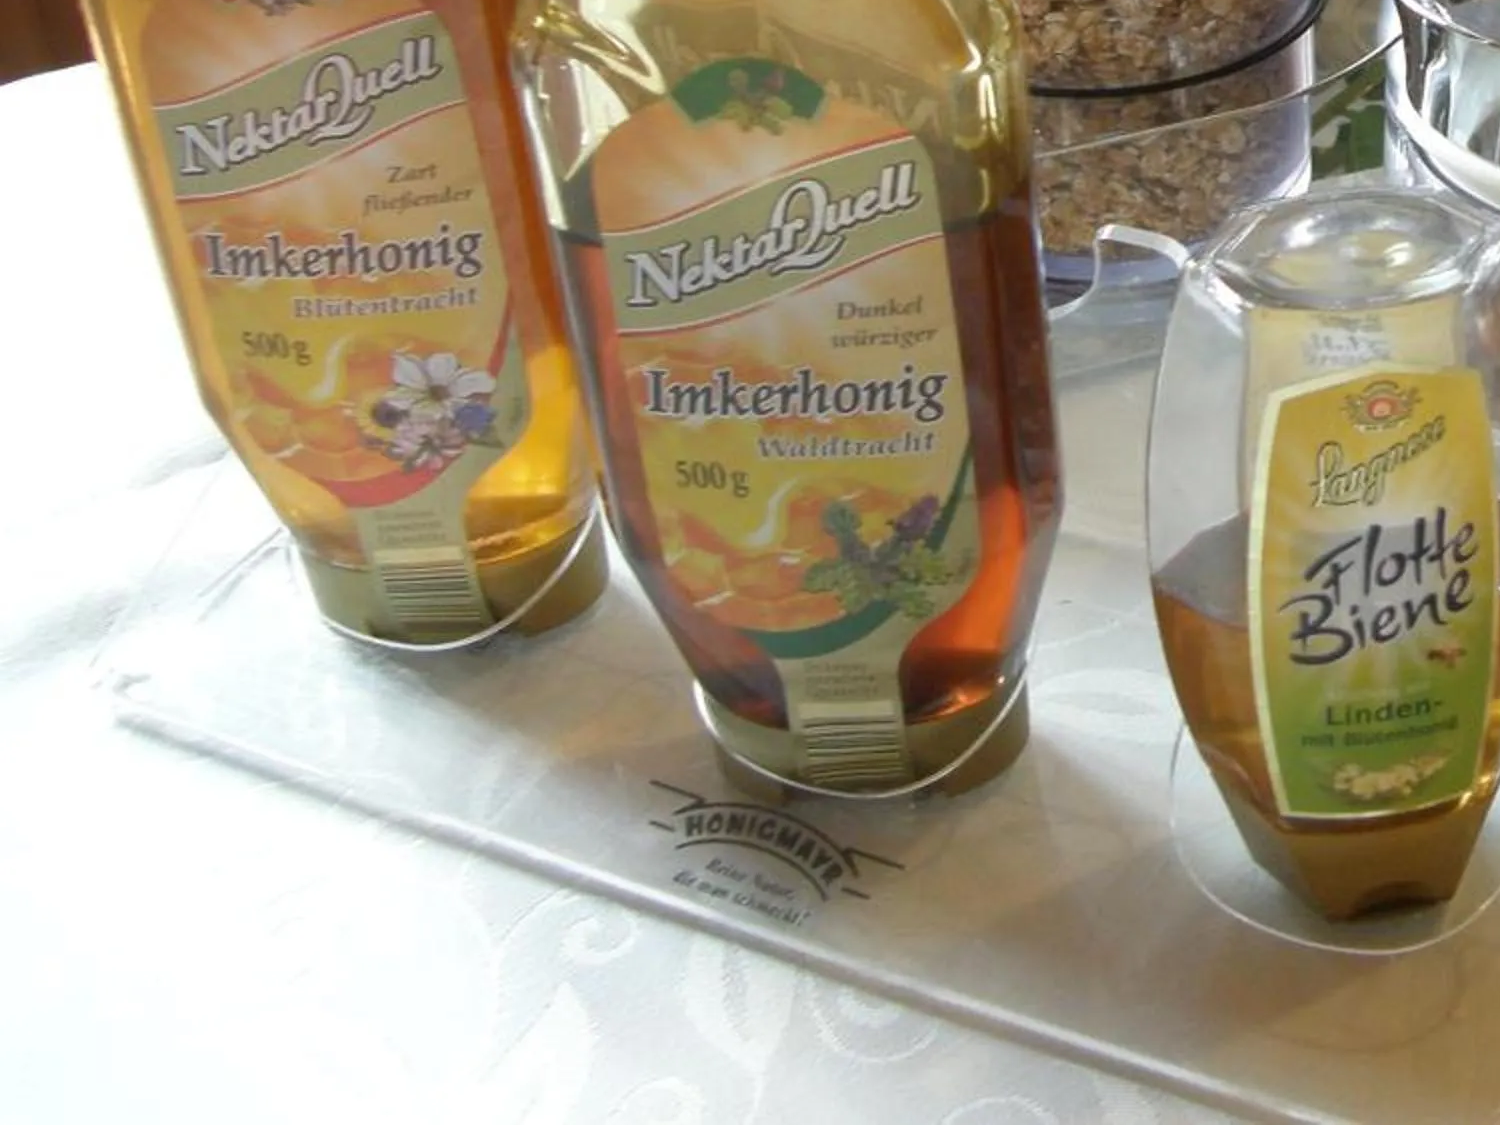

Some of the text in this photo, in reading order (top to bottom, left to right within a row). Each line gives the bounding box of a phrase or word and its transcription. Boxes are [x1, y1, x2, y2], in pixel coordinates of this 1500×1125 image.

[205, 225, 483, 278] Imkerhonig
[293, 287, 477, 318] Blütentracht
[837, 295, 923, 320] Dunkel
[646, 365, 948, 421] Imkerhonig
[757, 432, 936, 458] Waldtracht
[1304, 507, 1477, 601] Flotte
[1279, 568, 1476, 666] Biene
[1325, 698, 1443, 726] Linden-
